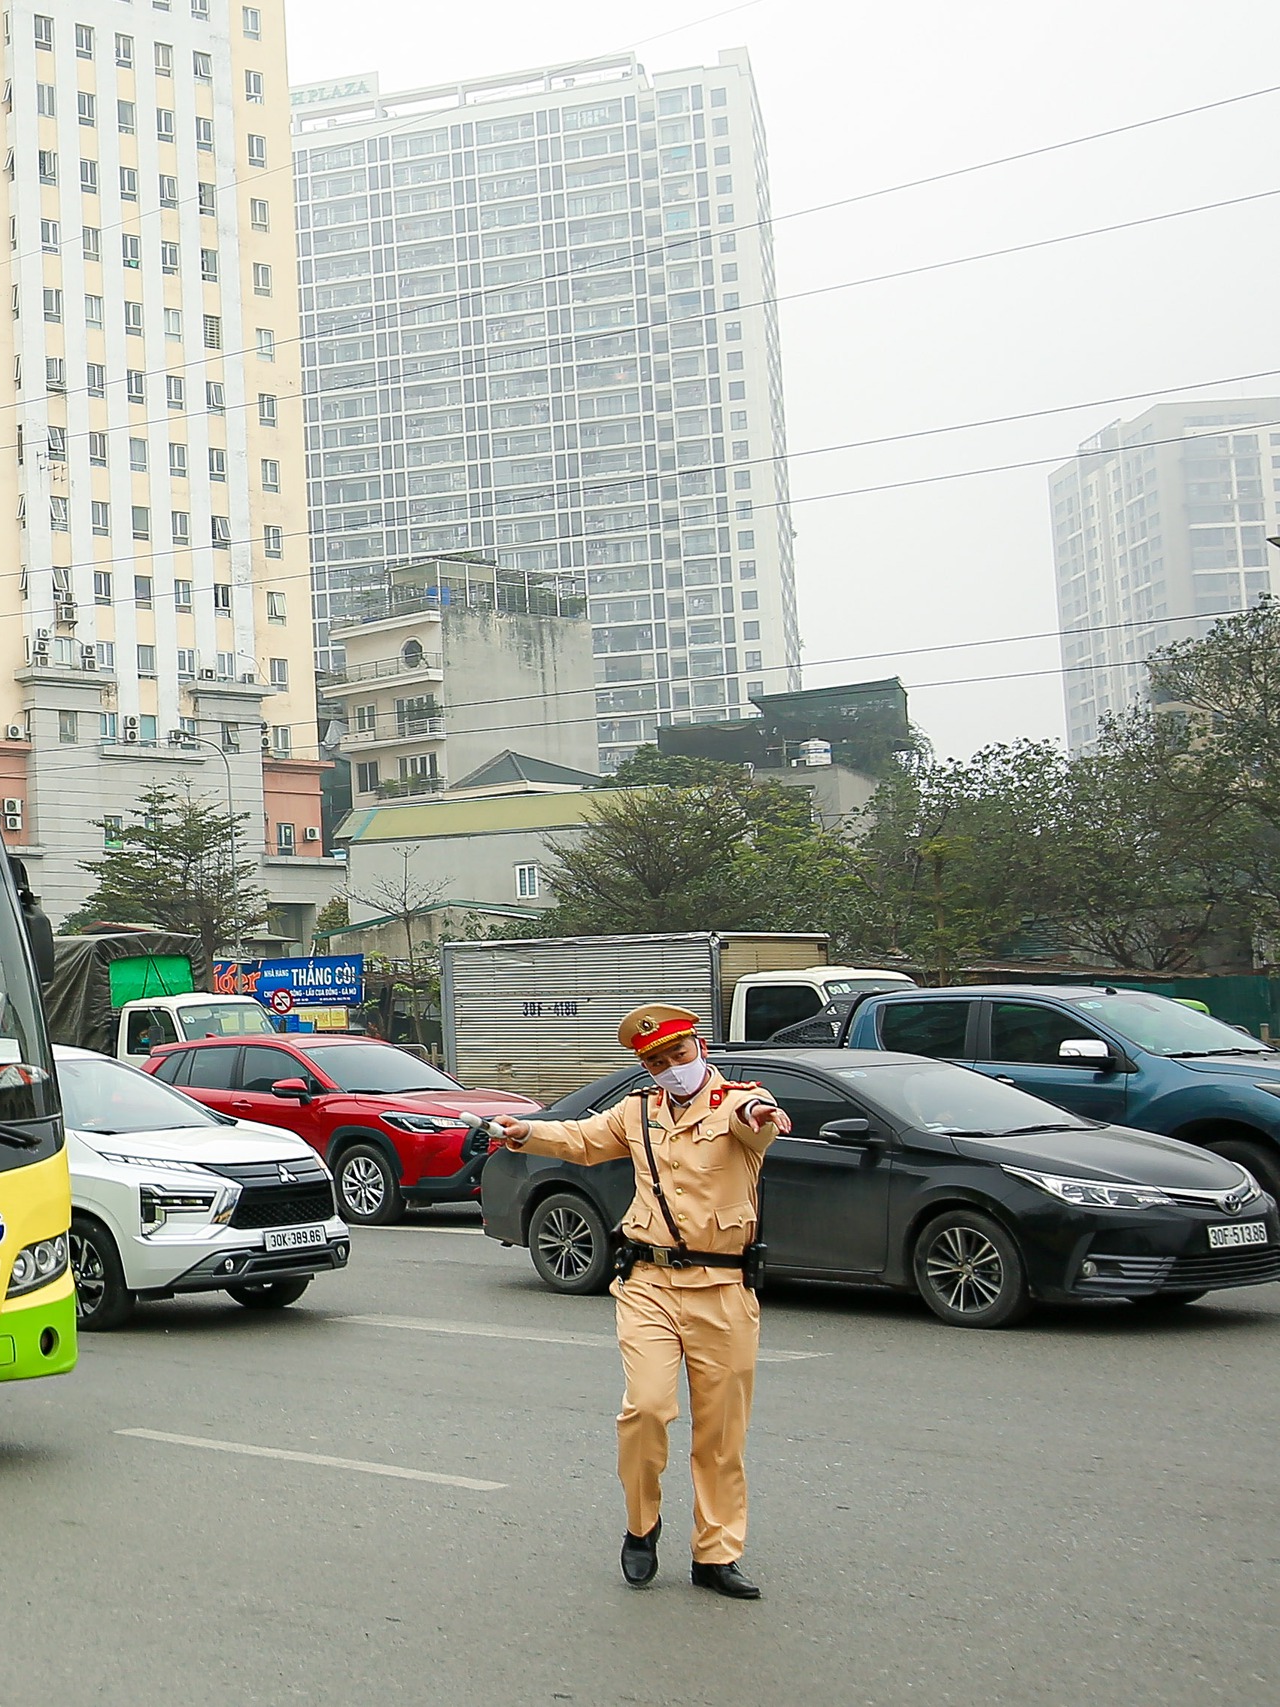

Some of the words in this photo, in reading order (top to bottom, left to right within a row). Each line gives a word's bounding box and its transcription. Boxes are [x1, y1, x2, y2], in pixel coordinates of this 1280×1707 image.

[307, 80, 370, 102] PLAZA
[291, 960, 332, 986] THẮNG
[270, 1230, 321, 1247] 30K-389.86
[1211, 1225, 1265, 1246] 30F-513.86
